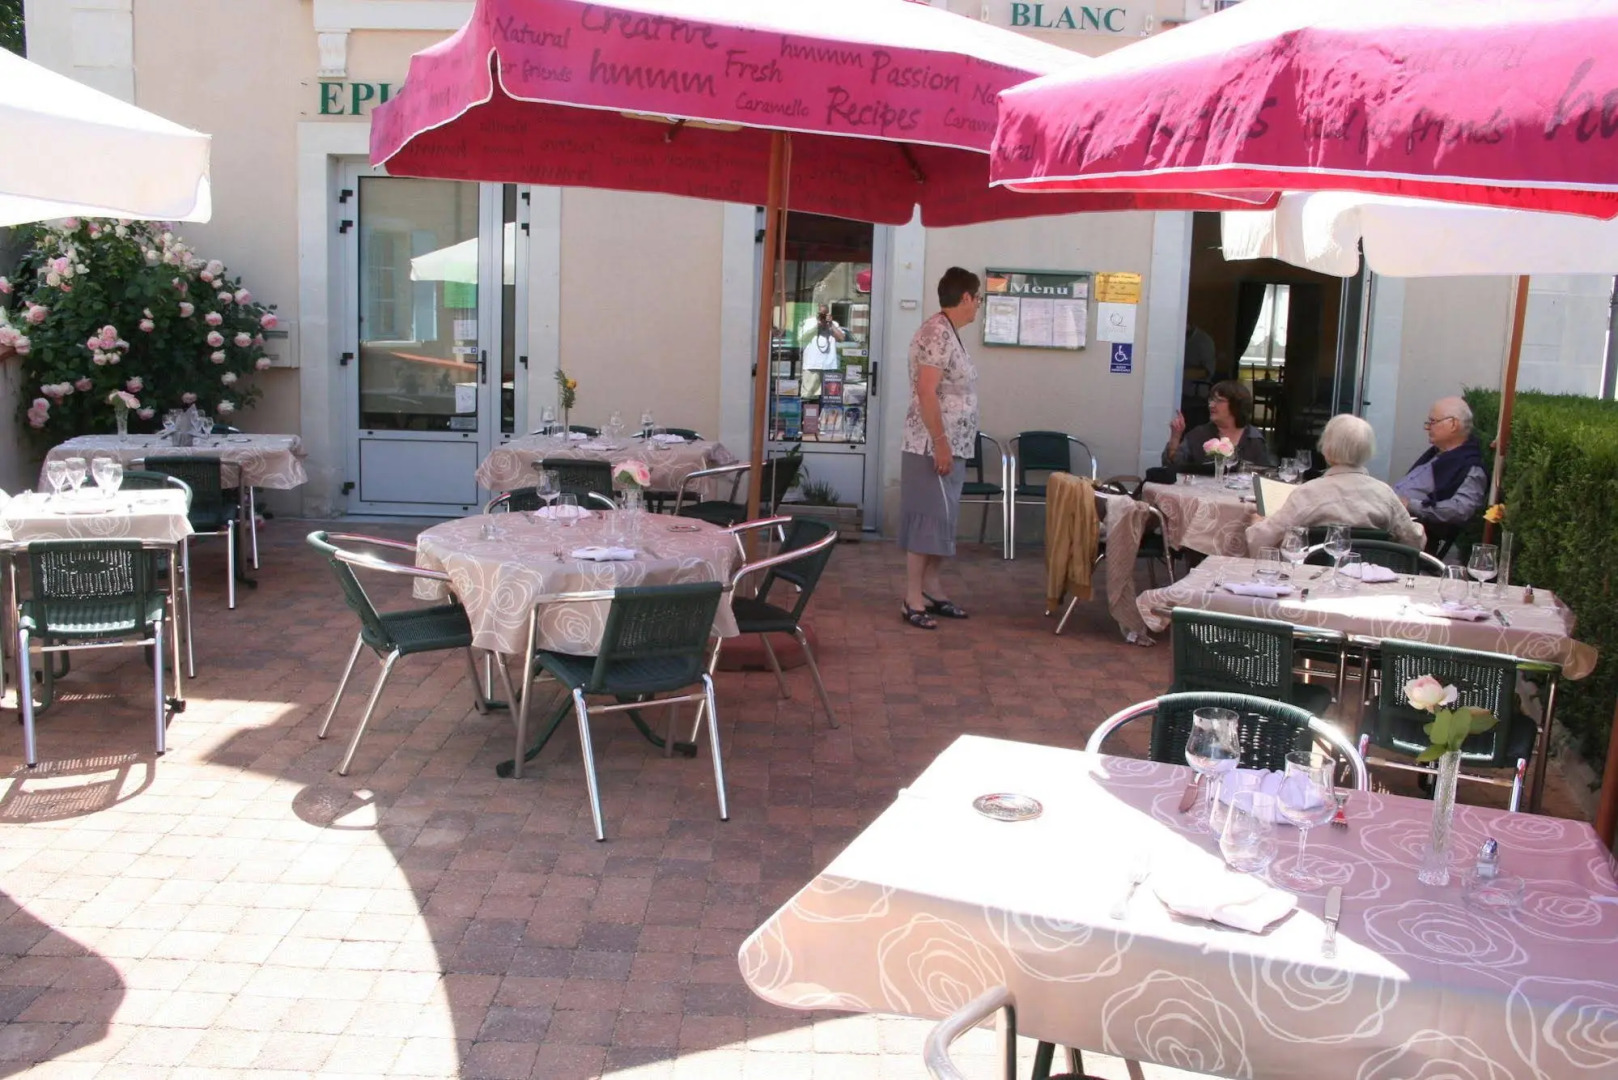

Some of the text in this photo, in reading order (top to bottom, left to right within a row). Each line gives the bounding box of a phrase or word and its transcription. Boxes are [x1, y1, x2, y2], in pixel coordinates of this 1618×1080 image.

[493, 17, 570, 48] Natural
[581, 4, 718, 49] Creative
[1010, 2, 1126, 33] BLANC
[725, 50, 783, 83] Fresh
[870, 50, 960, 93] Passion
[318, 82, 405, 115] EPI
[826, 86, 921, 136] Recipes
[972, 83, 997, 106] Na
[1010, 282, 1068, 295] Menu
